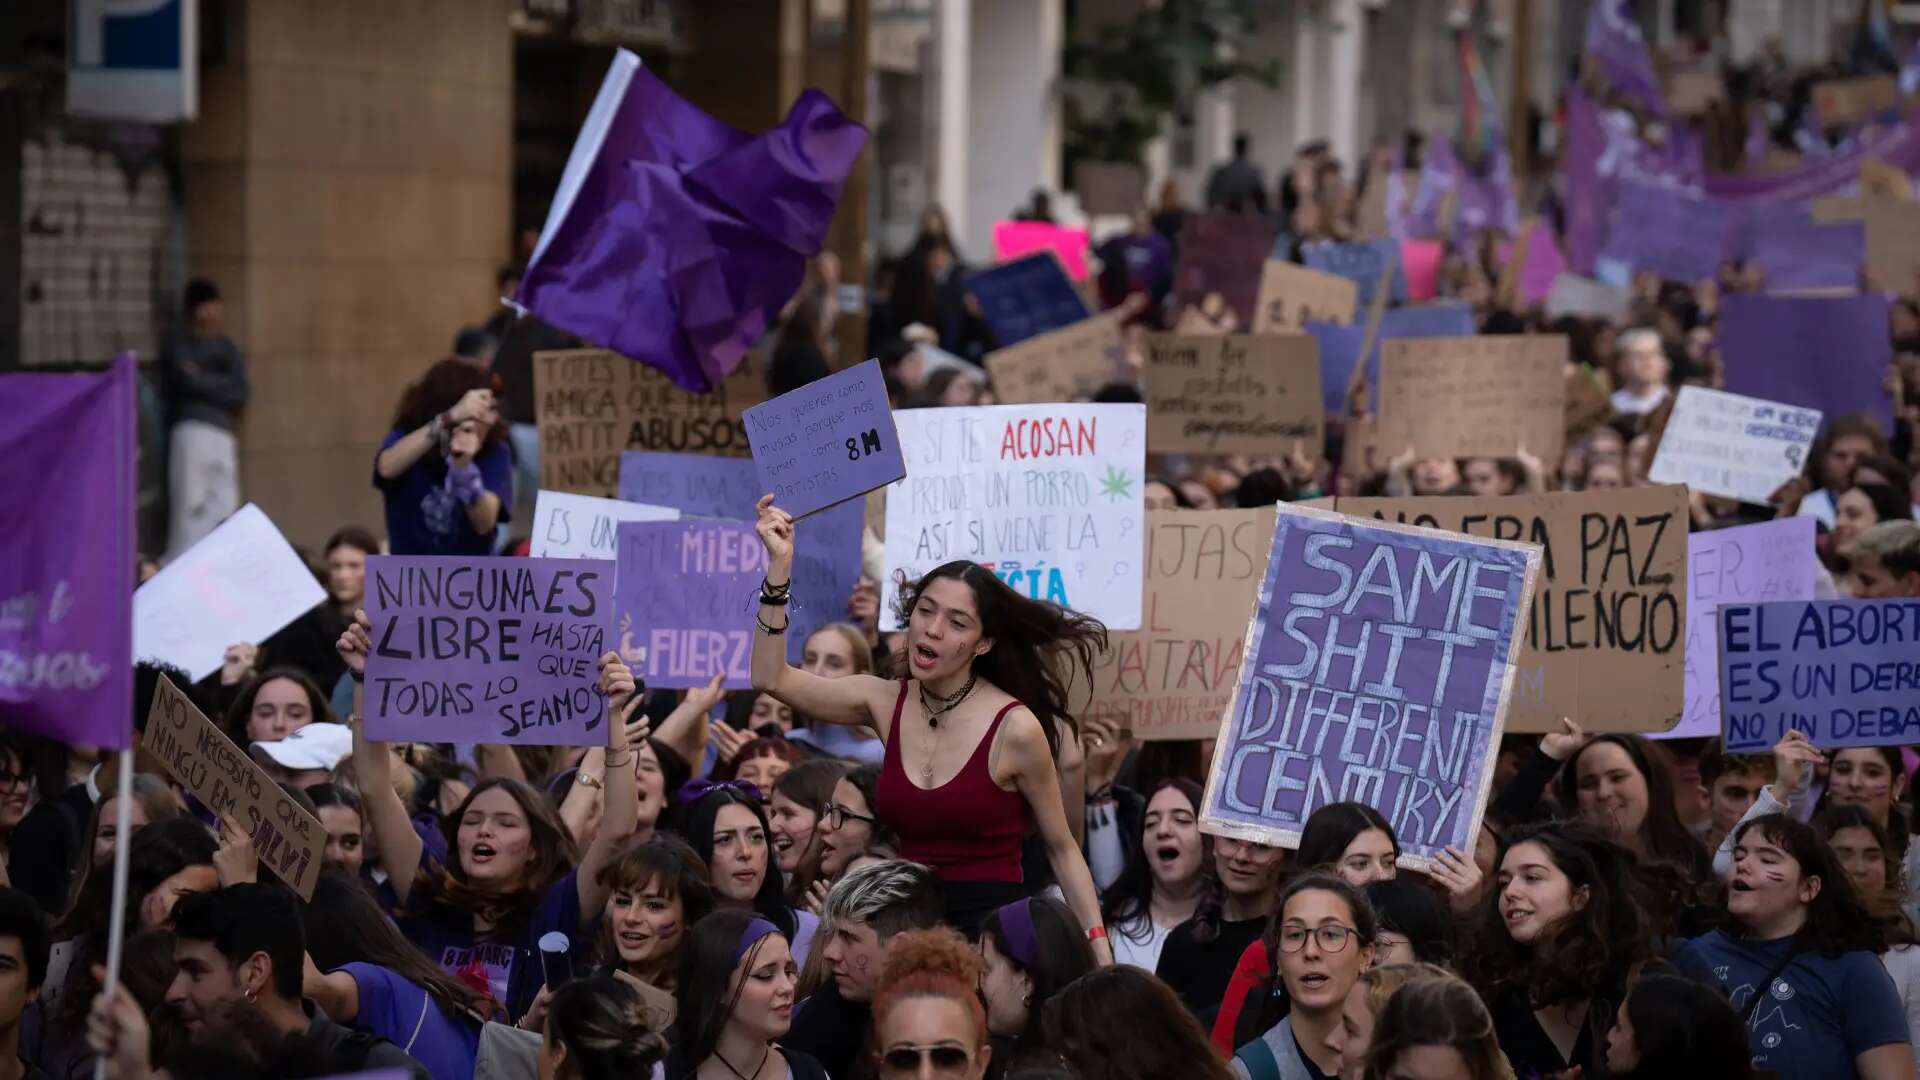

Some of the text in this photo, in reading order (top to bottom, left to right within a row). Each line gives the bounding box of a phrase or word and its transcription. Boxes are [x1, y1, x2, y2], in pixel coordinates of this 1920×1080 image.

[545, 386, 616, 417] AMIGA
[626, 384, 674, 412] QUE
[751, 410, 782, 432] Nos
[805, 410, 845, 440] porque
[853, 400, 875, 415] nos
[545, 422, 616, 452] PATIT
[845, 428, 882, 461] 8M
[958, 418, 984, 464] TE
[1000, 416, 1096, 460] ACOSAN
[912, 470, 1089, 515] PRENDE UN PORRO
[546, 507, 619, 550] ES UN
[994, 514, 1056, 552] VIENE
[1067, 514, 1099, 551] LA
[1580, 512, 1675, 588] PAZ
[376, 566, 540, 614] NINGUNA
[543, 570, 599, 617] ES
[1289, 532, 1512, 641] SAME
[376, 615, 604, 664] LIBRE HASTA
[1522, 588, 1681, 654] ILENCIO
[1724, 603, 1781, 653] EL
[537, 654, 591, 679] QUE
[1263, 606, 1479, 709] SHIT
[375, 675, 518, 718] TODAS LO
[1728, 660, 1781, 704] ES
[1792, 663, 1836, 699] UN
[157, 685, 188, 731] NO
[500, 681, 609, 738] SEAMOS
[1240, 675, 1479, 785] DIFFERENT
[1728, 711, 1766, 742] NO
[1778, 711, 1817, 741] UN
[1224, 743, 1464, 845] CENTURY
